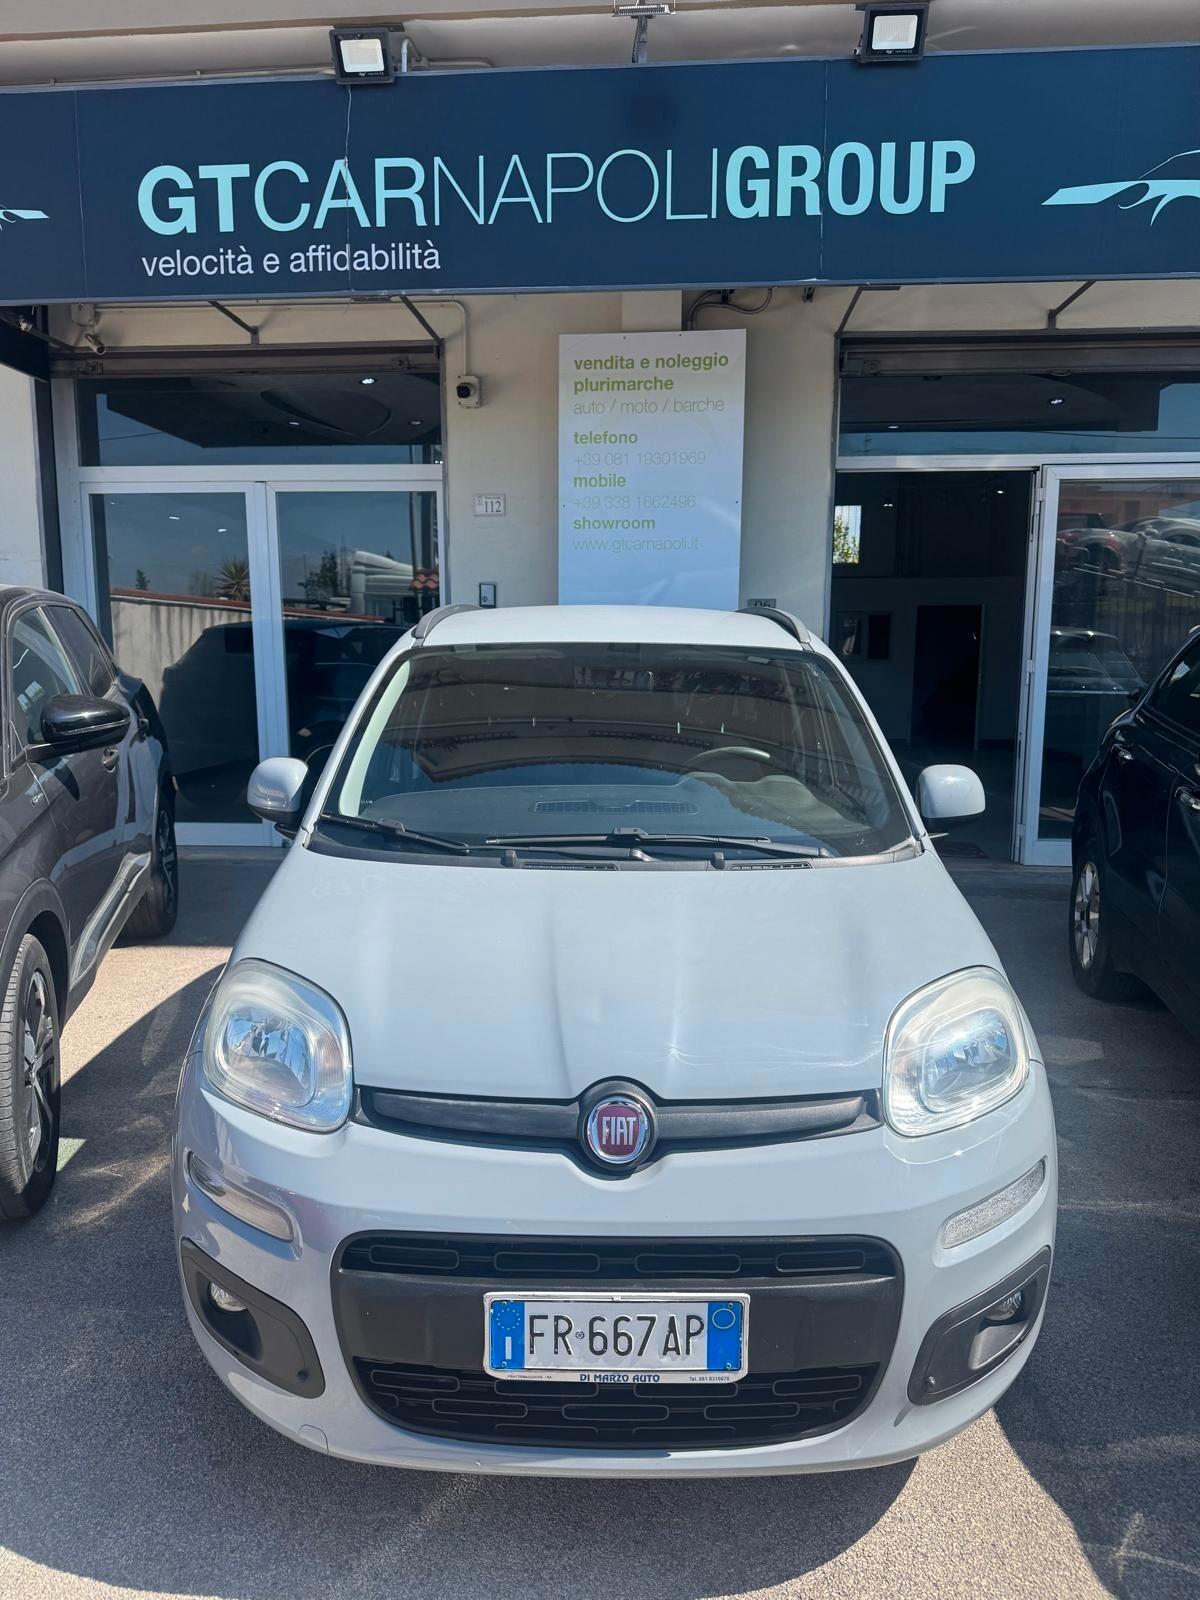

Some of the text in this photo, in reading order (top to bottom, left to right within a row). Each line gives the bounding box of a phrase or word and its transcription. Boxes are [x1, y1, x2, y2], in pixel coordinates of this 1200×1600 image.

[137, 140, 976, 236] GTCARNAPOLIGROUP
[142, 239, 441, 277] velocità e affidabilità
[574, 352, 729, 371] vendita e noleggio
[574, 376, 674, 395] plurimarche
[573, 400, 605, 415] auto
[620, 399, 658, 414] moto
[673, 396, 725, 412] barche
[573, 430, 638, 444] telefono
[574, 450, 706, 466] +39 081 19301969
[573, 473, 626, 488] mobile
[484, 500, 502, 513] 112
[574, 495, 601, 509] +39
[604, 495, 630, 509] 338
[573, 515, 656, 530] showroom
[602, 1116, 637, 1146] FIAT
[579, 1373, 660, 1383] DI MARZO AUTO
